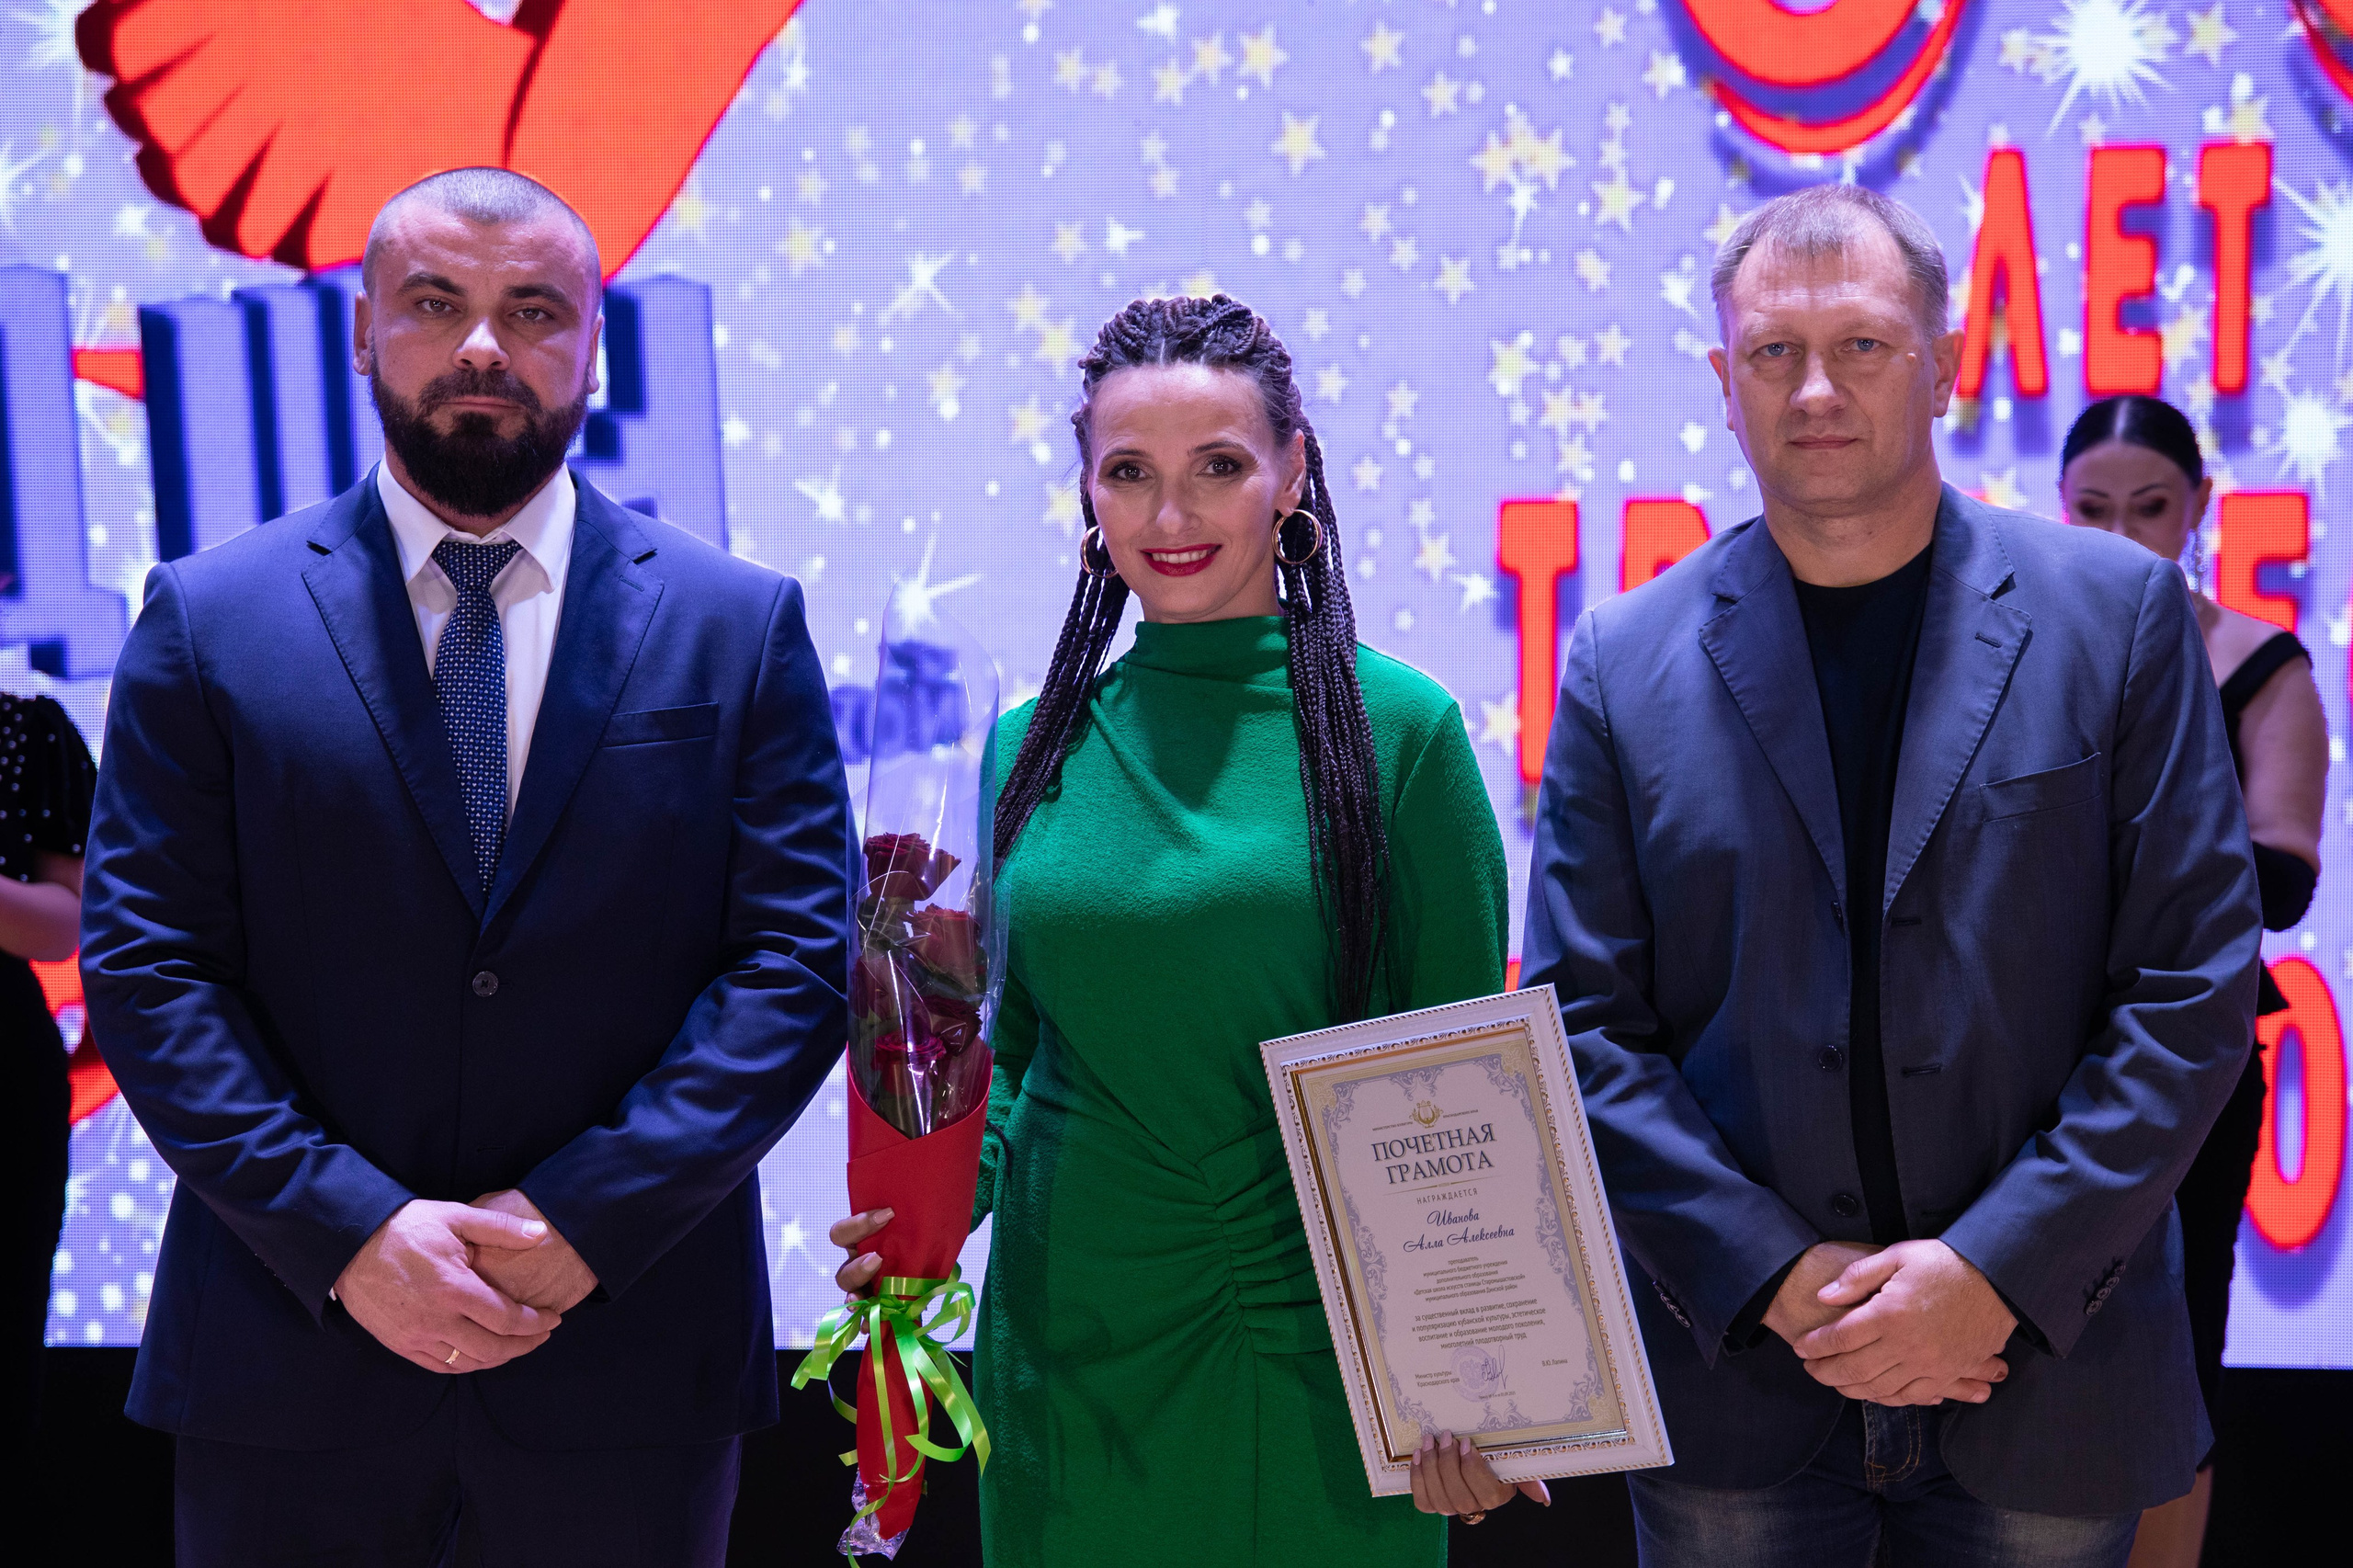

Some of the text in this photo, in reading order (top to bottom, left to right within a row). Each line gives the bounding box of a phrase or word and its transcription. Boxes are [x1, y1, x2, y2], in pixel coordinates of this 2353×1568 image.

[1956, 142, 2274, 398] ЛЕТ
[1371, 1122, 1496, 1162] ПОЧЕТНАЯ
[1385, 1150, 1494, 1185] ГРАМОТА
[1416, 1187, 1478, 1205] НАГРАЖДАЕТСЯ
[1427, 1207, 1479, 1227] Иванова
[1403, 1224, 1515, 1253] Алла Алексеевна
[1423, 1260, 1508, 1278] муниципального бюджетного учреждения
[1448, 1256, 1479, 1266] преподаватель
[1437, 1270, 1498, 1284] дополнительного образования
[1425, 1292, 1460, 1303] муниципального
[1459, 1289, 1486, 1297] образования
[1505, 1283, 1518, 1291] район
[1416, 1321, 1457, 1332] популяризацию
[1457, 1315, 1485, 1327] кубанской
[1485, 1313, 1511, 1324] культуры,
[1511, 1308, 1546, 1318] эстетическое
[1421, 1308, 1459, 1322] существенный
[1459, 1307, 1475, 1315] вклад
[1480, 1303, 1506, 1313] развитие,
[1506, 1299, 1538, 1309] сохранение
[1418, 1333, 1449, 1342] воспитание
[1453, 1327, 1488, 1338] образование
[1488, 1324, 1514, 1332] молодого
[1515, 1319, 1545, 1328] поколения,
[1440, 1332, 1528, 1349] многолетний плодотворный труд
[1416, 1379, 1449, 1388] Краснодарского
[1433, 1370, 1452, 1379] культуры
